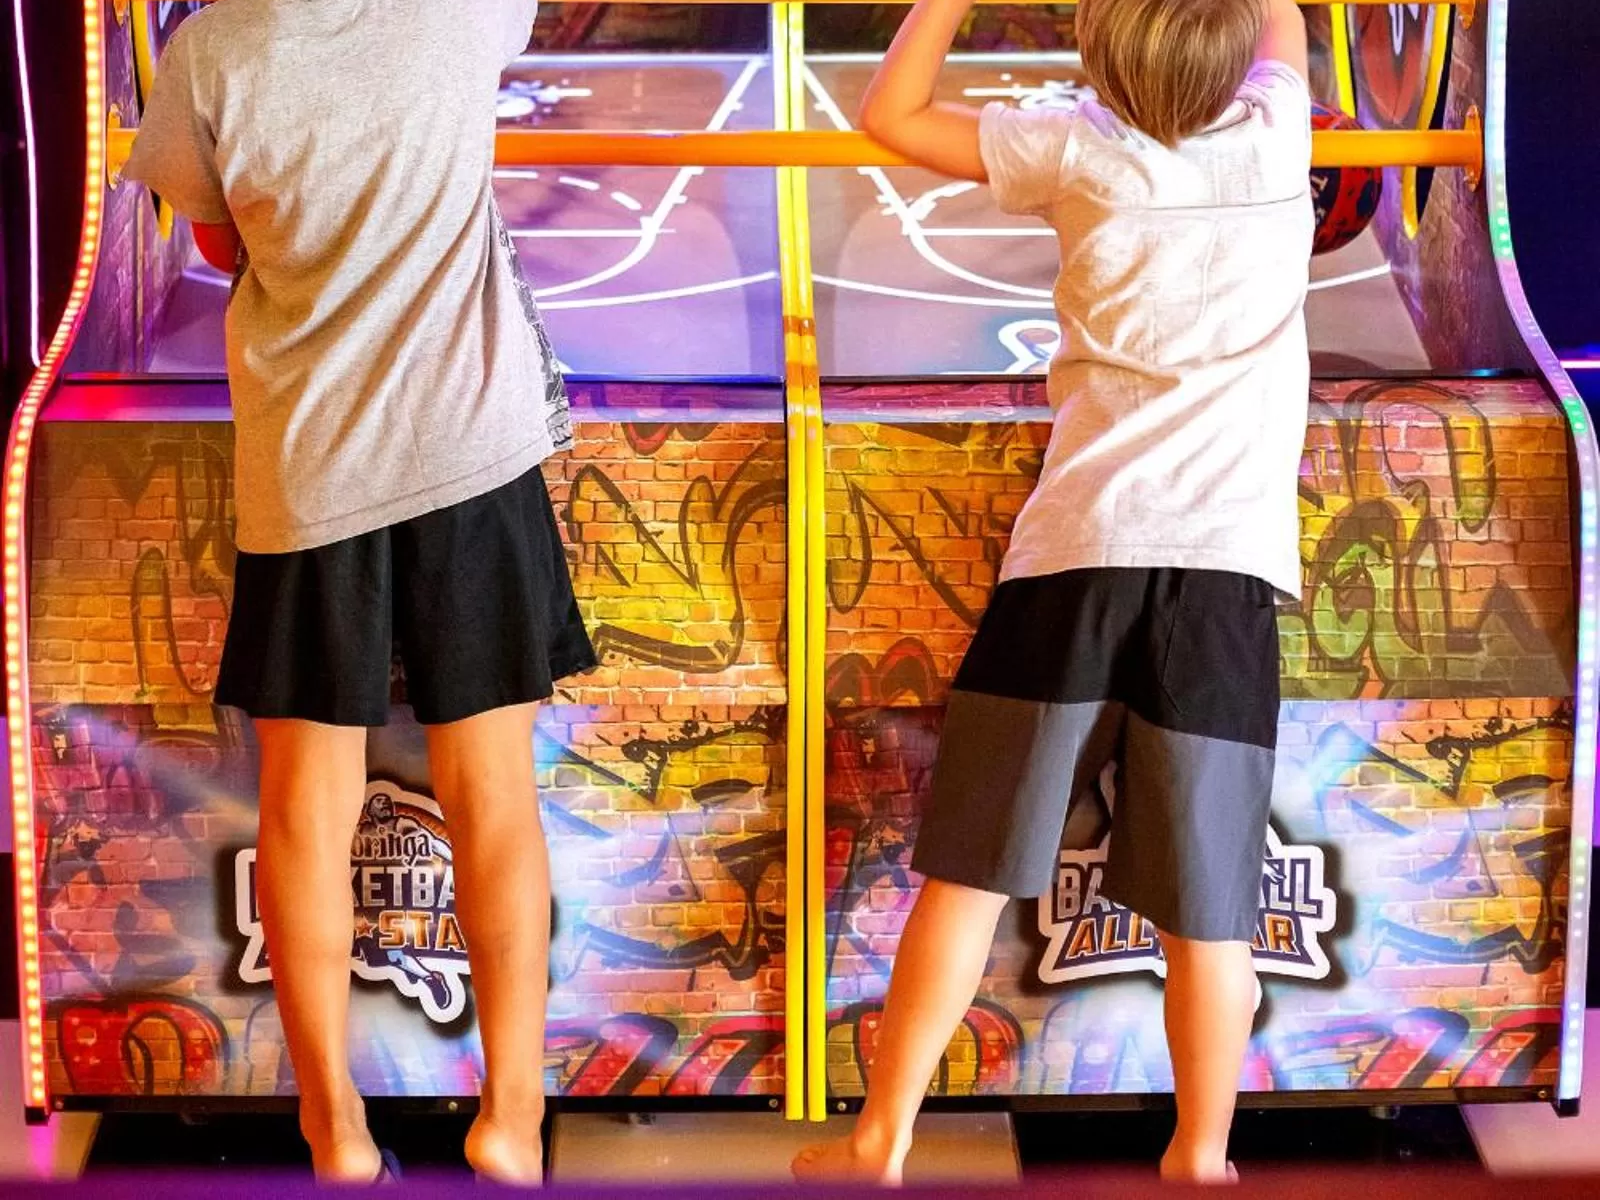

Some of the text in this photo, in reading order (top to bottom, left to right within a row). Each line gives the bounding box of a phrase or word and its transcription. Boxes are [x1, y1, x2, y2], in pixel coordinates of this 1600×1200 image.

[351, 826, 431, 866] oringa
[379, 910, 468, 952] STA
[1065, 913, 1152, 961] ALL
